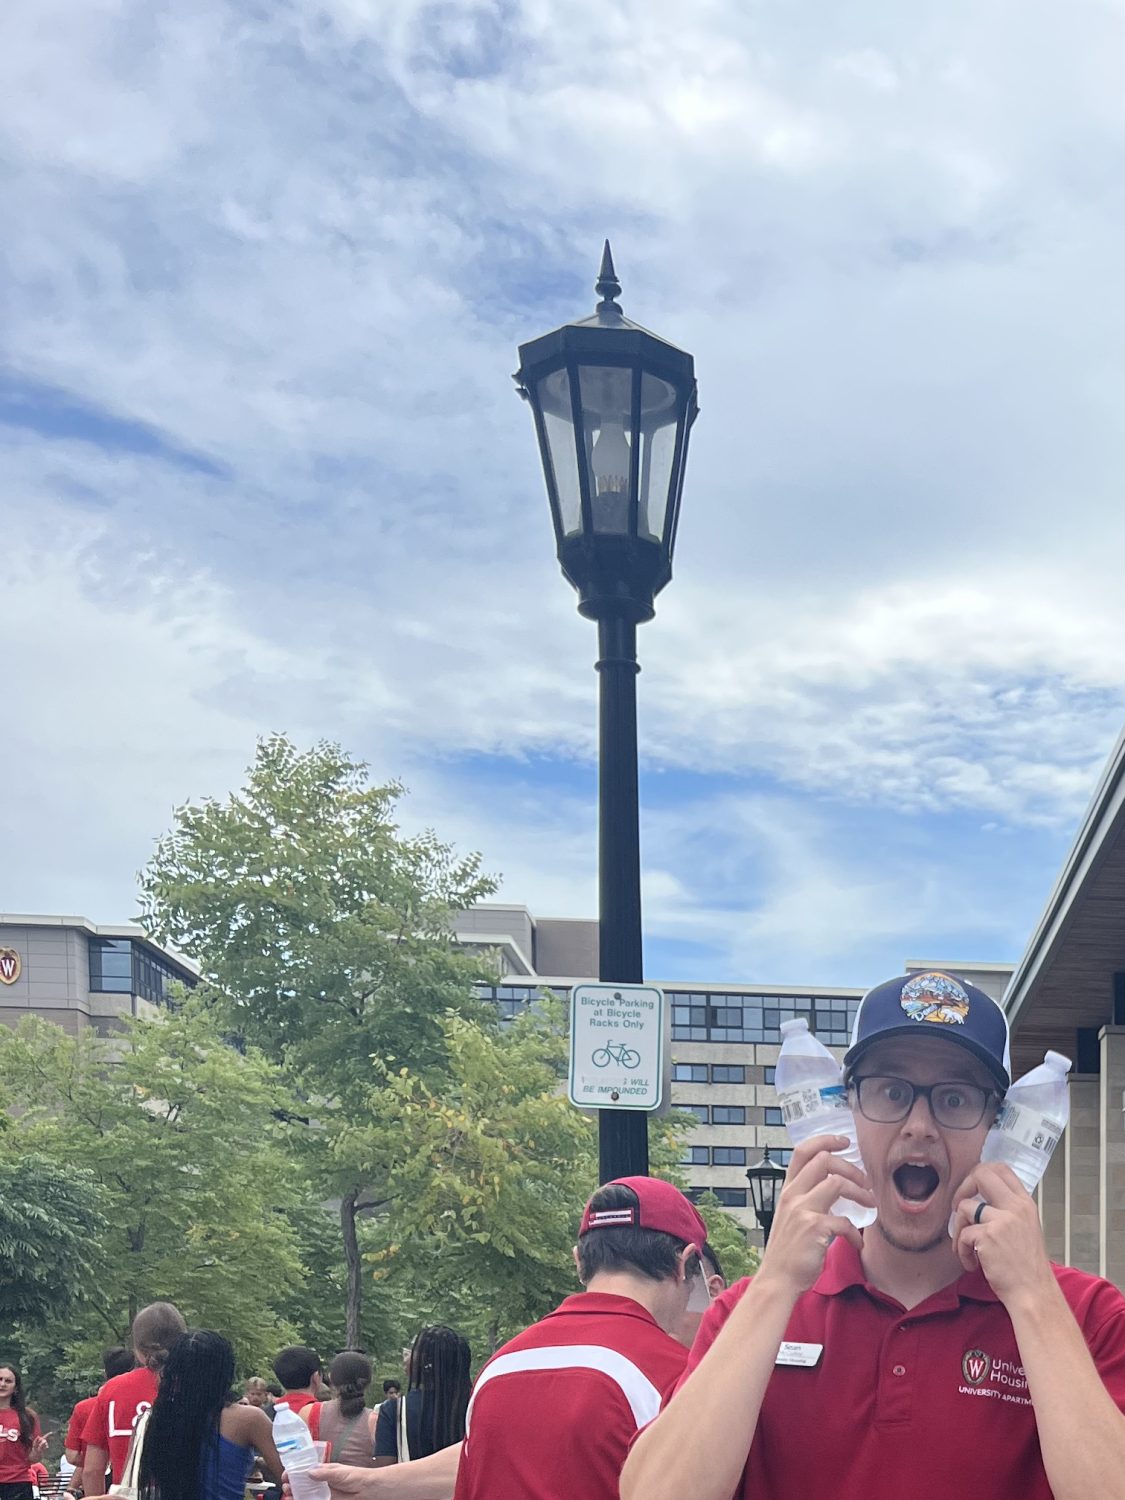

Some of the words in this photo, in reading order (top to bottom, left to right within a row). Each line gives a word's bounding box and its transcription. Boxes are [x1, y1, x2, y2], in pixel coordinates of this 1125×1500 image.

[581, 997, 615, 1007] Bicycle
[619, 999, 654, 1009] Parking
[607, 1008, 641, 1018] Bicycle
[590, 1018, 619, 1028] Racks
[623, 1020, 644, 1030] Only
[630, 1078, 649, 1086] WILL
[583, 1085, 594, 1093] BE
[597, 1086, 648, 1095] IMPOUNDED
[969, 1359, 984, 1379] W
[992, 1360, 1025, 1376] Unive
[959, 1386, 1001, 1399] UNIVERSITY
[1001, 1394, 1032, 1405] APARTM
